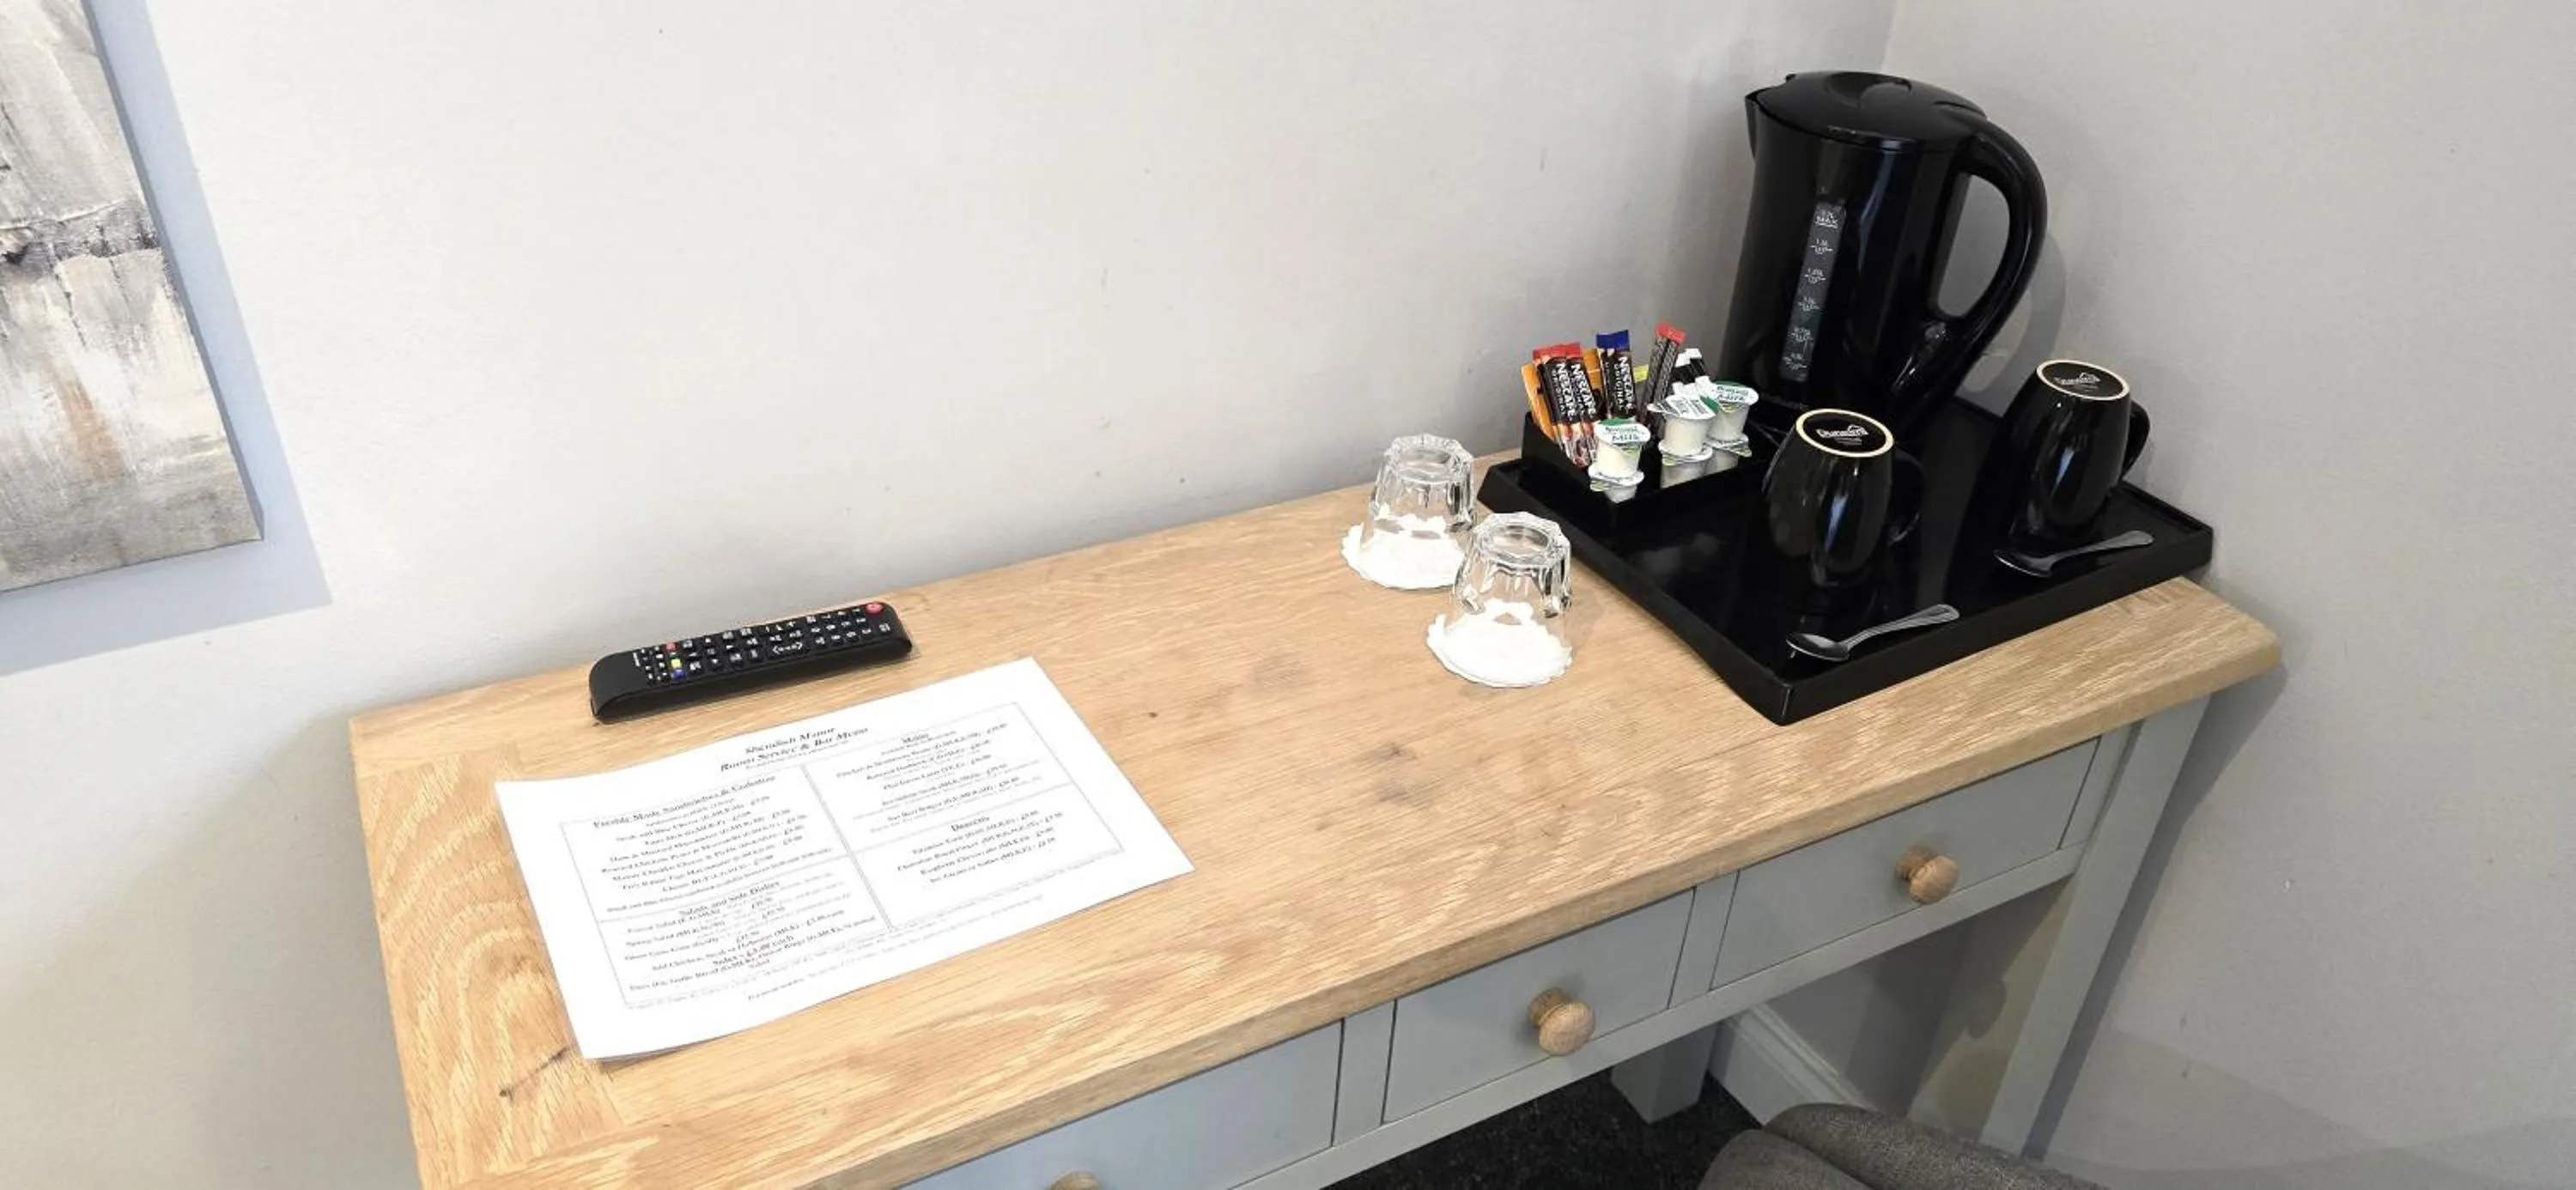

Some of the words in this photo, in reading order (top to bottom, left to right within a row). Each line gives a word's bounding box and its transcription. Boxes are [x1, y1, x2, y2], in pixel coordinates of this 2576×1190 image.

[720, 754, 756, 772] Room
[758, 747, 798, 762] Service
[815, 735, 833, 746] Bar
[836, 727, 869, 740] Menu
[799, 727, 835, 742] Manor
